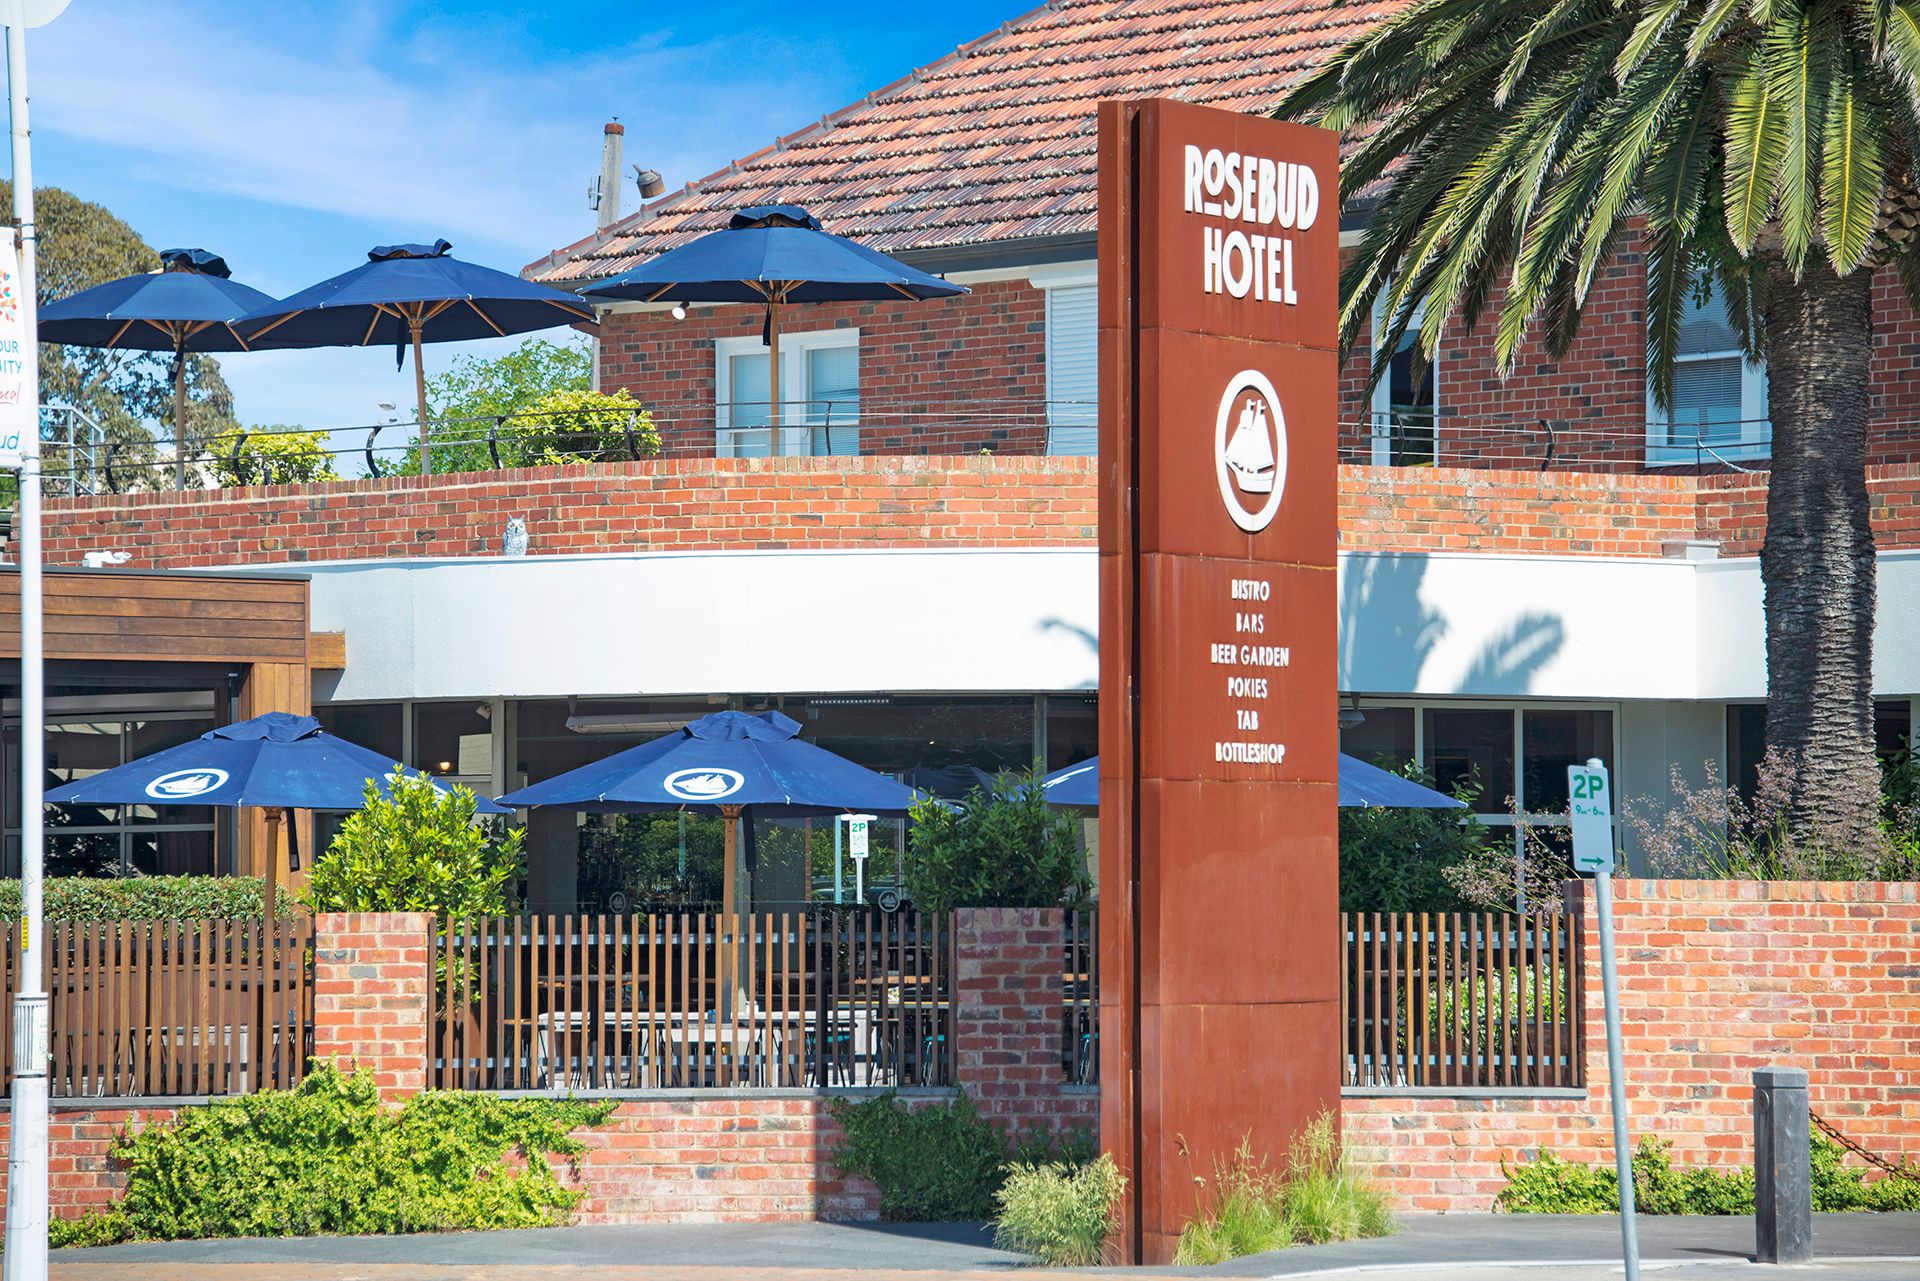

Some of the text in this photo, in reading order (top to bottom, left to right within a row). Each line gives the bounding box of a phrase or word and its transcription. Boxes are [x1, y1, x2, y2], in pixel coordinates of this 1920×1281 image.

[1185, 144, 1319, 231] ROSEBUD
[1204, 226, 1297, 305] HOTEL
[0, 359, 22, 374] ITY
[1231, 579, 1270, 601] BISTRO
[1236, 612, 1264, 634] BARS
[1211, 643, 1289, 667] BEER GARDEN
[1228, 677, 1268, 699] POKIES
[1236, 710, 1259, 730] TAB
[1215, 742, 1285, 764] BOTTLESHOP
[1573, 774, 1603, 799] 2P
[851, 822, 866, 832] 2P
